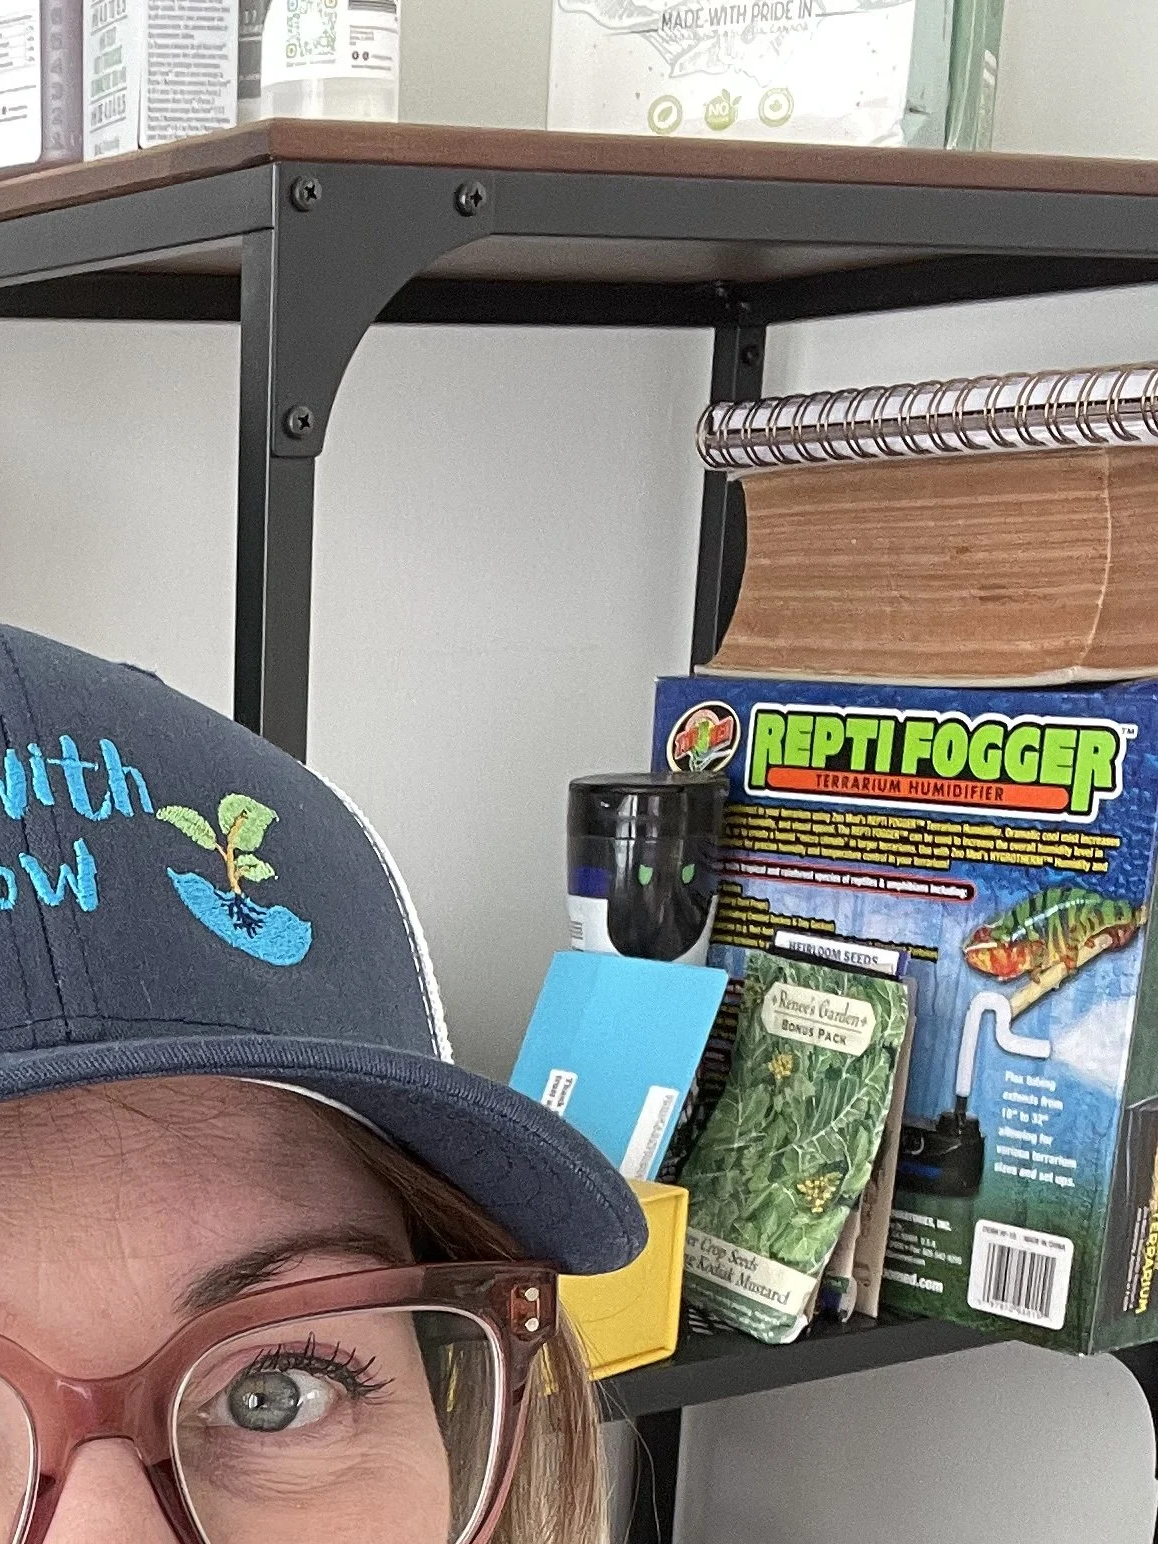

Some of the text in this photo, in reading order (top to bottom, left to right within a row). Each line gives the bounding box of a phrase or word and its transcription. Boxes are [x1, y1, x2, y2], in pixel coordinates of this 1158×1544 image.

[662, 0, 813, 31] MADE WITH PRIDE IN
[708, 103, 730, 116] NO
[750, 712, 895, 787] REPTI
[901, 720, 1117, 812] FOGGER
[815, 773, 1004, 802] TERRARIUM HUMIDIFIER
[789, 940, 879, 965] HEIRLOOM SEEDS
[778, 989, 860, 1028] Renee's Garden
[781, 1018, 847, 1046] BONUS PACK
[1026, 1075, 1057, 1093] tubing
[1002, 1091, 1064, 1111] extends from
[1019, 1111, 1030, 1123] to
[998, 1125, 1054, 1147] allowing for
[996, 1144, 1077, 1170] various terrarium
[994, 1161, 1076, 1189] sizes and set ups.
[728, 1248, 759, 1272] Seeds
[735, 1272, 792, 1306] Mustard
